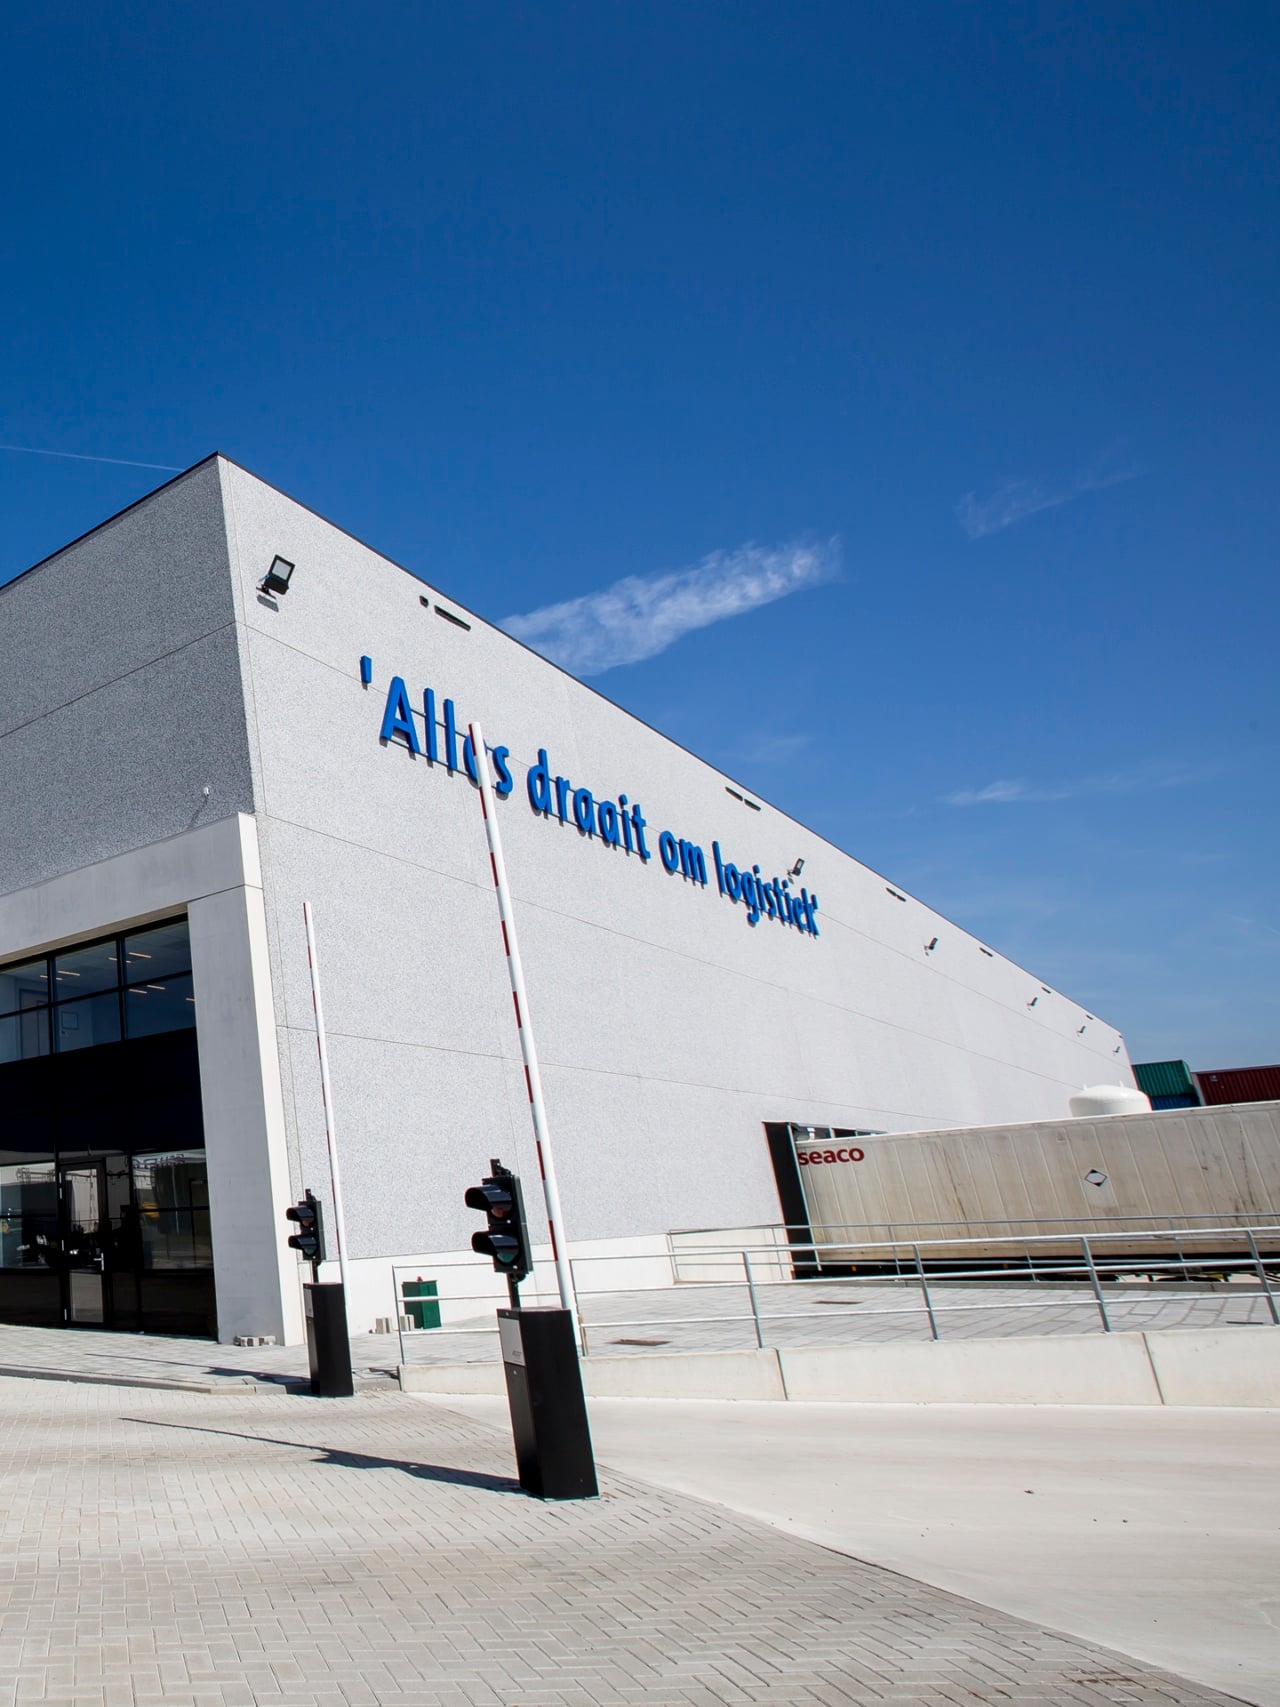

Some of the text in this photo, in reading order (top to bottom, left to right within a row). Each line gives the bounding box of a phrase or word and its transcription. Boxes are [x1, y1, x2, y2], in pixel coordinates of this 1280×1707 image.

[527, 748, 652, 860] draait
[659, 830, 708, 885] om
[798, 1147, 865, 1166] seaco
